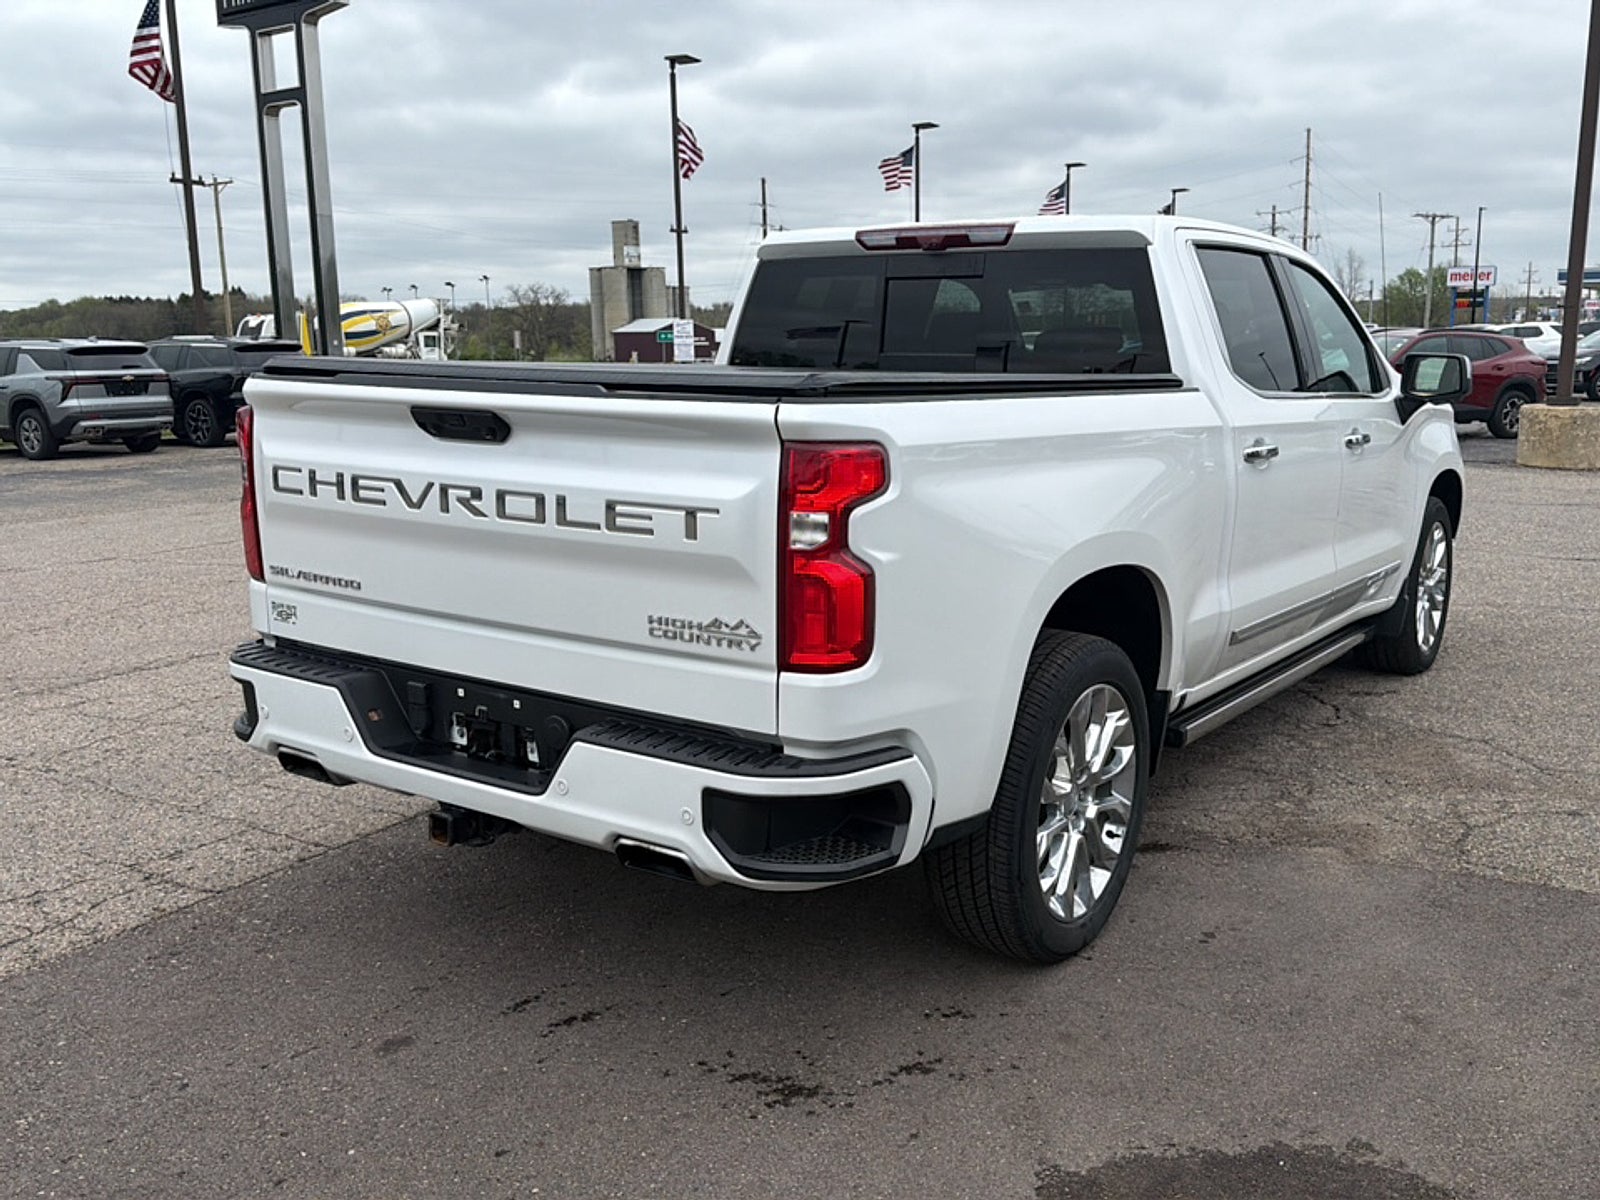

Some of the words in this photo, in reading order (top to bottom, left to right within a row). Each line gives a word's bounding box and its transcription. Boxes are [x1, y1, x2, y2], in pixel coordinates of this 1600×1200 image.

[1450, 268, 1492, 282] meier
[272, 465, 720, 541] CHEVROLET
[269, 564, 361, 591] SILVERADO
[647, 615, 703, 631] HIGH
[648, 626, 762, 652] COUNTRY
